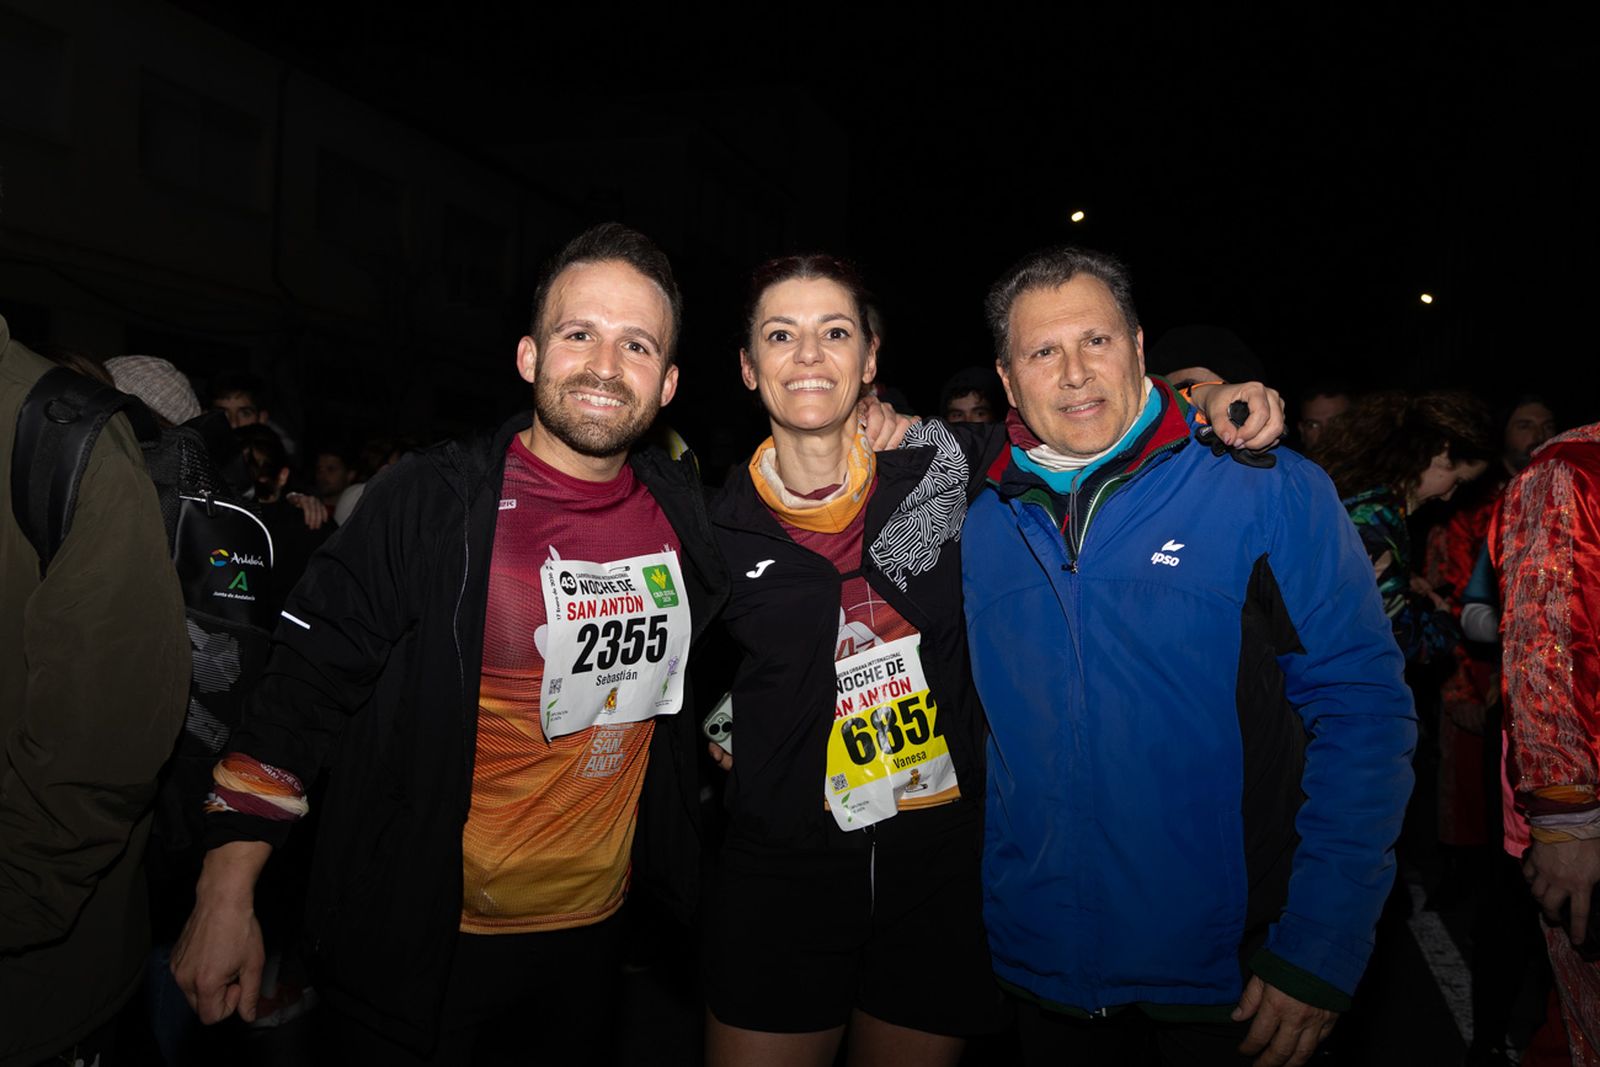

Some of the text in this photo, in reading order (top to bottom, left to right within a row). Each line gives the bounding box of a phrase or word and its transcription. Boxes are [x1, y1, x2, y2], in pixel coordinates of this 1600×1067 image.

[579, 578, 637, 595] NOCHE DE
[567, 592, 644, 621] SAN ANTÓN
[571, 614, 668, 675] 2355
[885, 657, 906, 677] DE
[595, 669, 638, 686] Sebastián
[834, 676, 913, 720] AN ANTÓN
[893, 750, 927, 769] Vanesa
